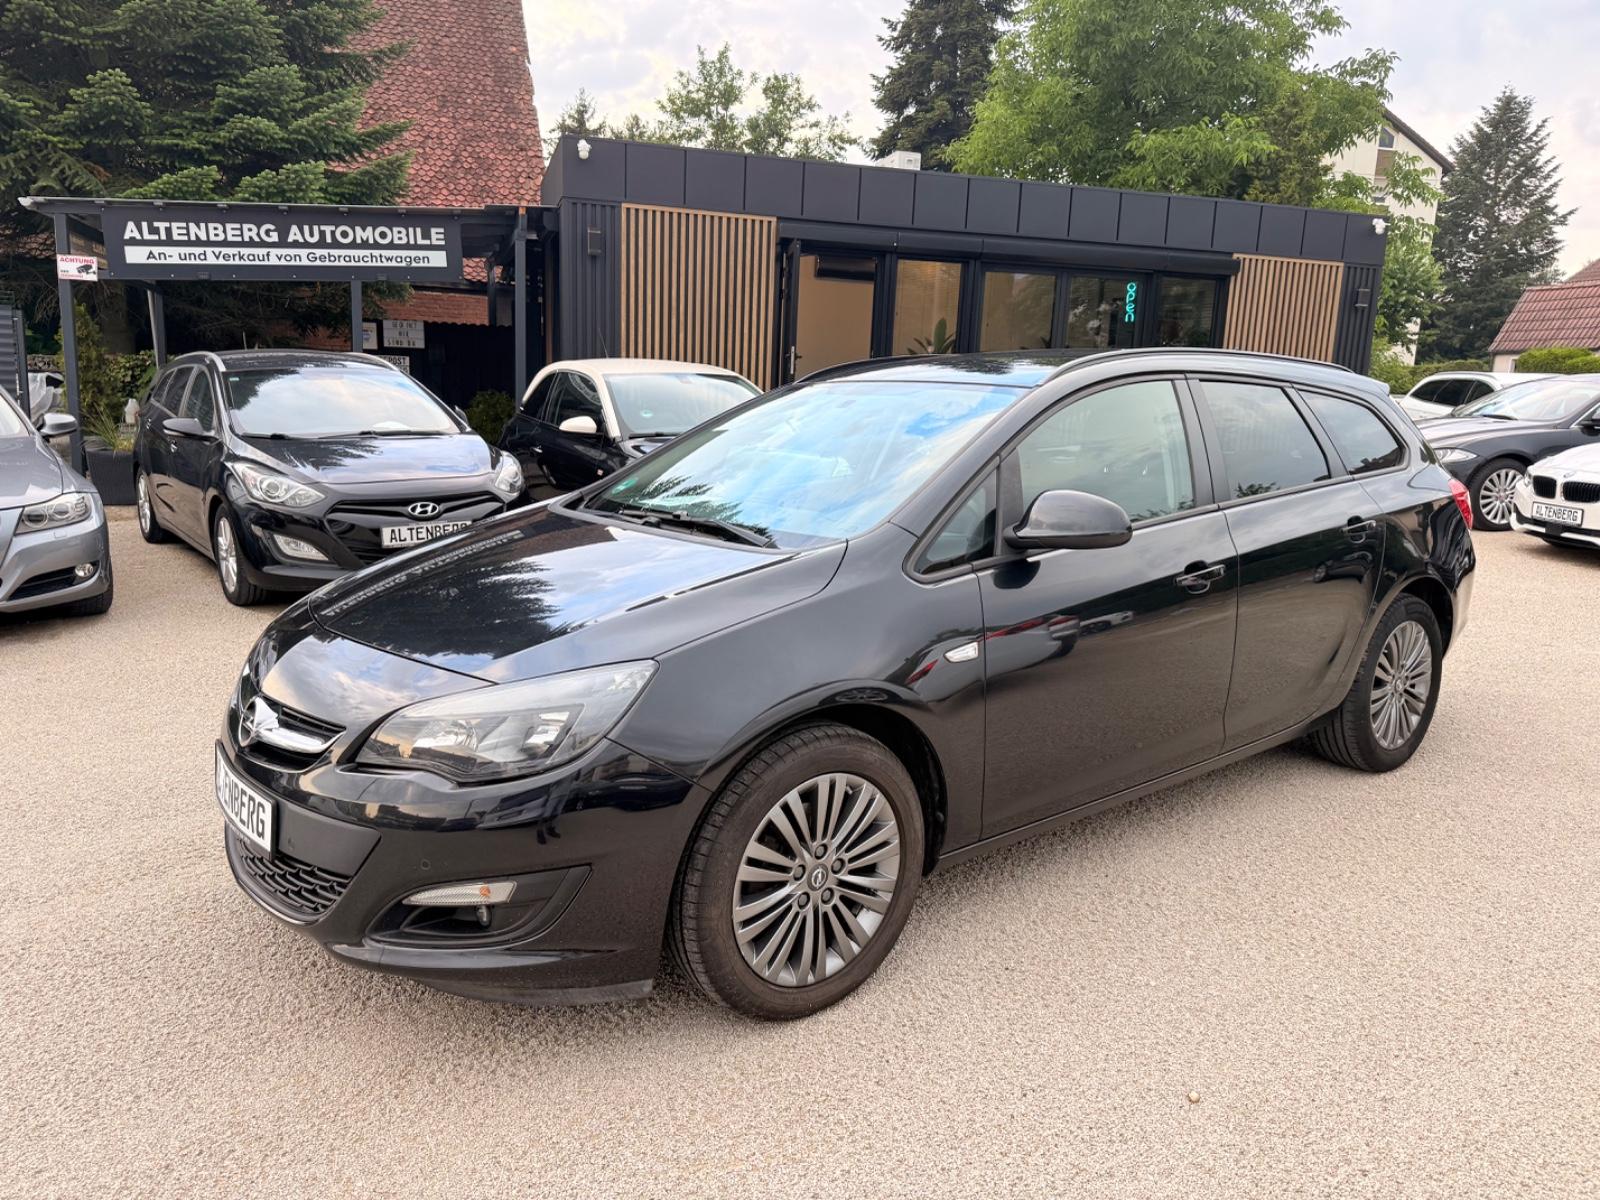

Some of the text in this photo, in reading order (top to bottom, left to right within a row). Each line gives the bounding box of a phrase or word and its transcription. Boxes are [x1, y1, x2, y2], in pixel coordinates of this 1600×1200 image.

[123, 220, 446, 246] ALTENBERG AUTOMOBILE
[59, 255, 95, 265] ACHTUNG
[146, 250, 430, 266] An- und Verkauf von Gebrauchtwagen
[1535, 505, 1579, 522] ALTENBERG
